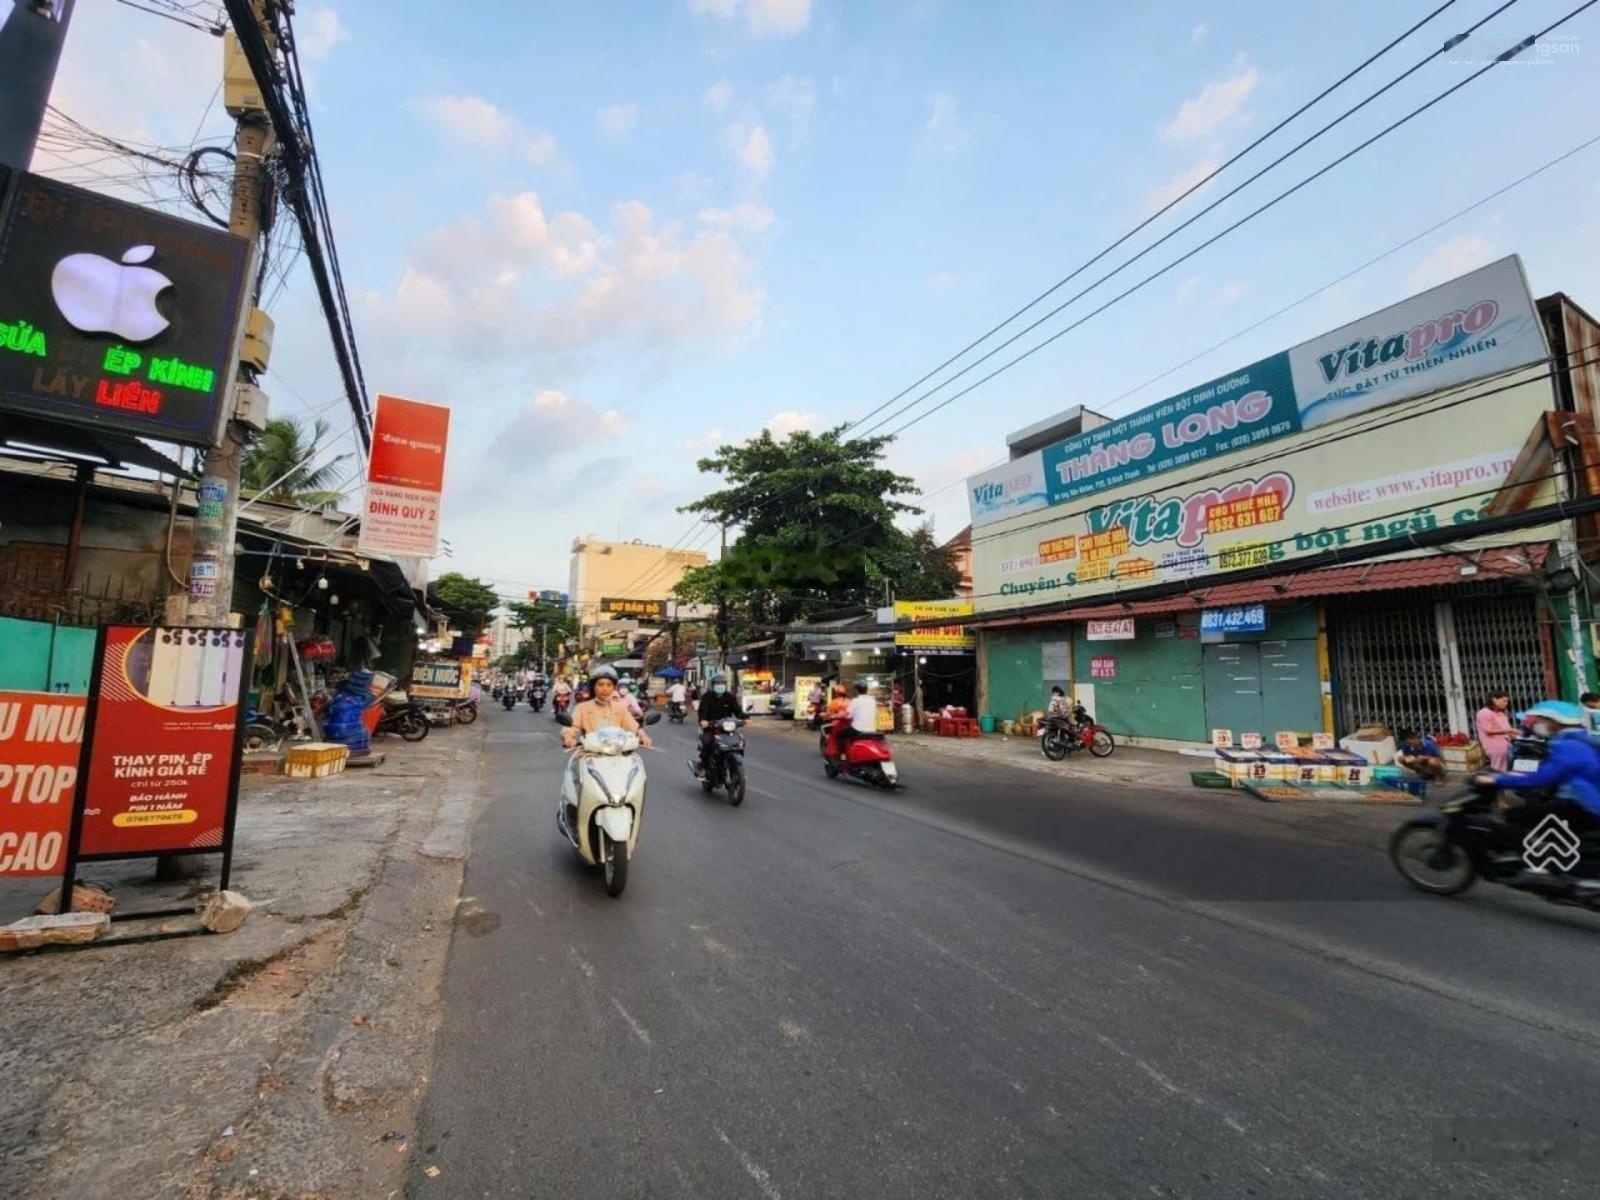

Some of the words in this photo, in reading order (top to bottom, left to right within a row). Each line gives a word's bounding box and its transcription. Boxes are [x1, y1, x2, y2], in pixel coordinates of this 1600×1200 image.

[1318, 299, 1499, 384] Vitapro
[1404, 356, 1444, 375] THIÊN
[1449, 338, 1497, 361] NHIÊN
[102, 343, 143, 374] ÉP
[148, 357, 215, 391] KÍNH
[1056, 432, 1155, 484] THĂNG
[1162, 390, 1272, 449] LONG
[1313, 486, 1371, 511] website:
[1375, 457, 1515, 499] www.vitapro.vn
[429, 510, 436, 521] 2
[25, 704, 86, 743] MU
[112, 754, 157, 766] THAY
[114, 766, 154, 778] KÍNH
[0, 831, 63, 873] CAO
